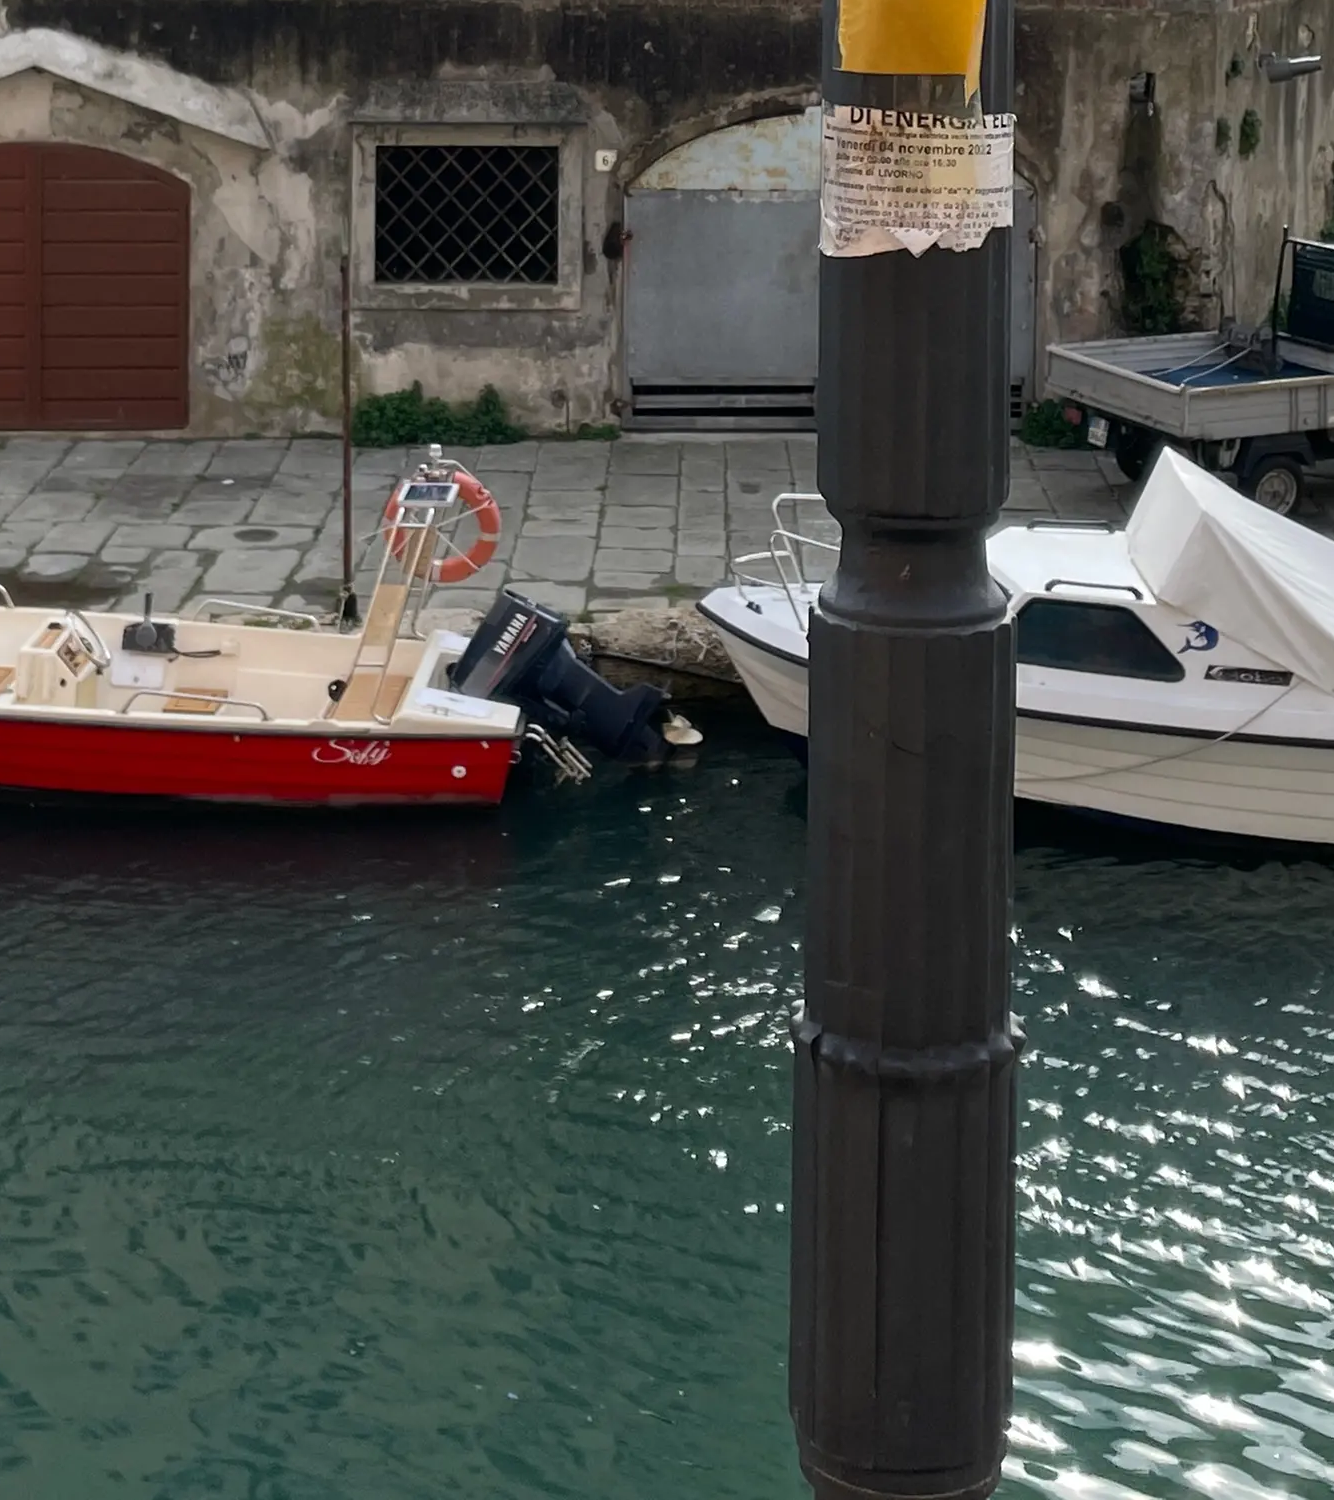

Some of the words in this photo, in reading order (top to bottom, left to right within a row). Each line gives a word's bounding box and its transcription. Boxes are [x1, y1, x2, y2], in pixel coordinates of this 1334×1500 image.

[851, 106, 871, 125] DI
[879, 142, 894, 153] 04
[898, 143, 965, 156] novembre
[602, 155, 609, 167] 6
[878, 168, 924, 179] LIVORNO
[492, 612, 529, 655] YAMAHA
